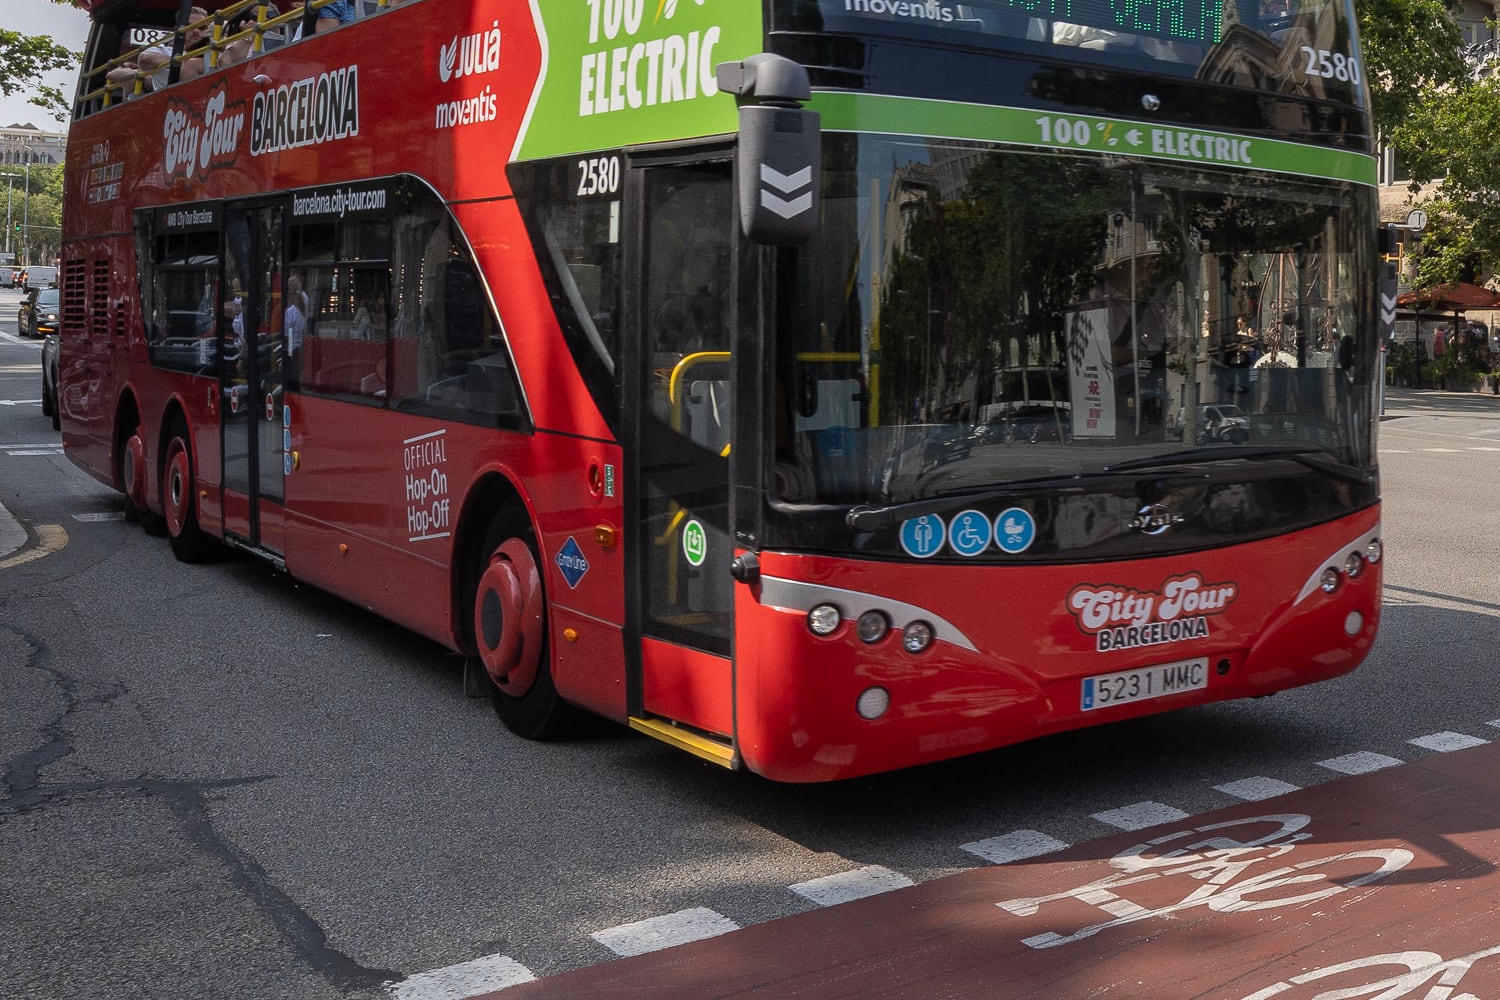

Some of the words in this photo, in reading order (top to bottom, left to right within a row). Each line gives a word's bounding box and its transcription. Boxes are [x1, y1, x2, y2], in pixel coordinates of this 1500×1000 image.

[579, 25, 721, 117] ELECTRIC
[1300, 45, 1360, 85] 2580
[163, 108, 200, 179] City
[199, 90, 244, 169] Tour
[250, 65, 359, 157] BARCELONA
[435, 85, 497, 129] moventis
[1151, 129, 1252, 164] ELECTRIC
[577, 156, 619, 196] 2580
[293, 188, 386, 218] barcelona.city-tour.com
[404, 438, 447, 471] OFFICIAL
[405, 468, 448, 506] Hop-On
[407, 499, 450, 536] Hop-Off
[1072, 590, 1154, 628] City
[1157, 577, 1235, 620] Tour
[1097, 616, 1209, 652] BARCELONA
[1099, 671, 1153, 703] 5231
[1162, 663, 1203, 691] MMC
